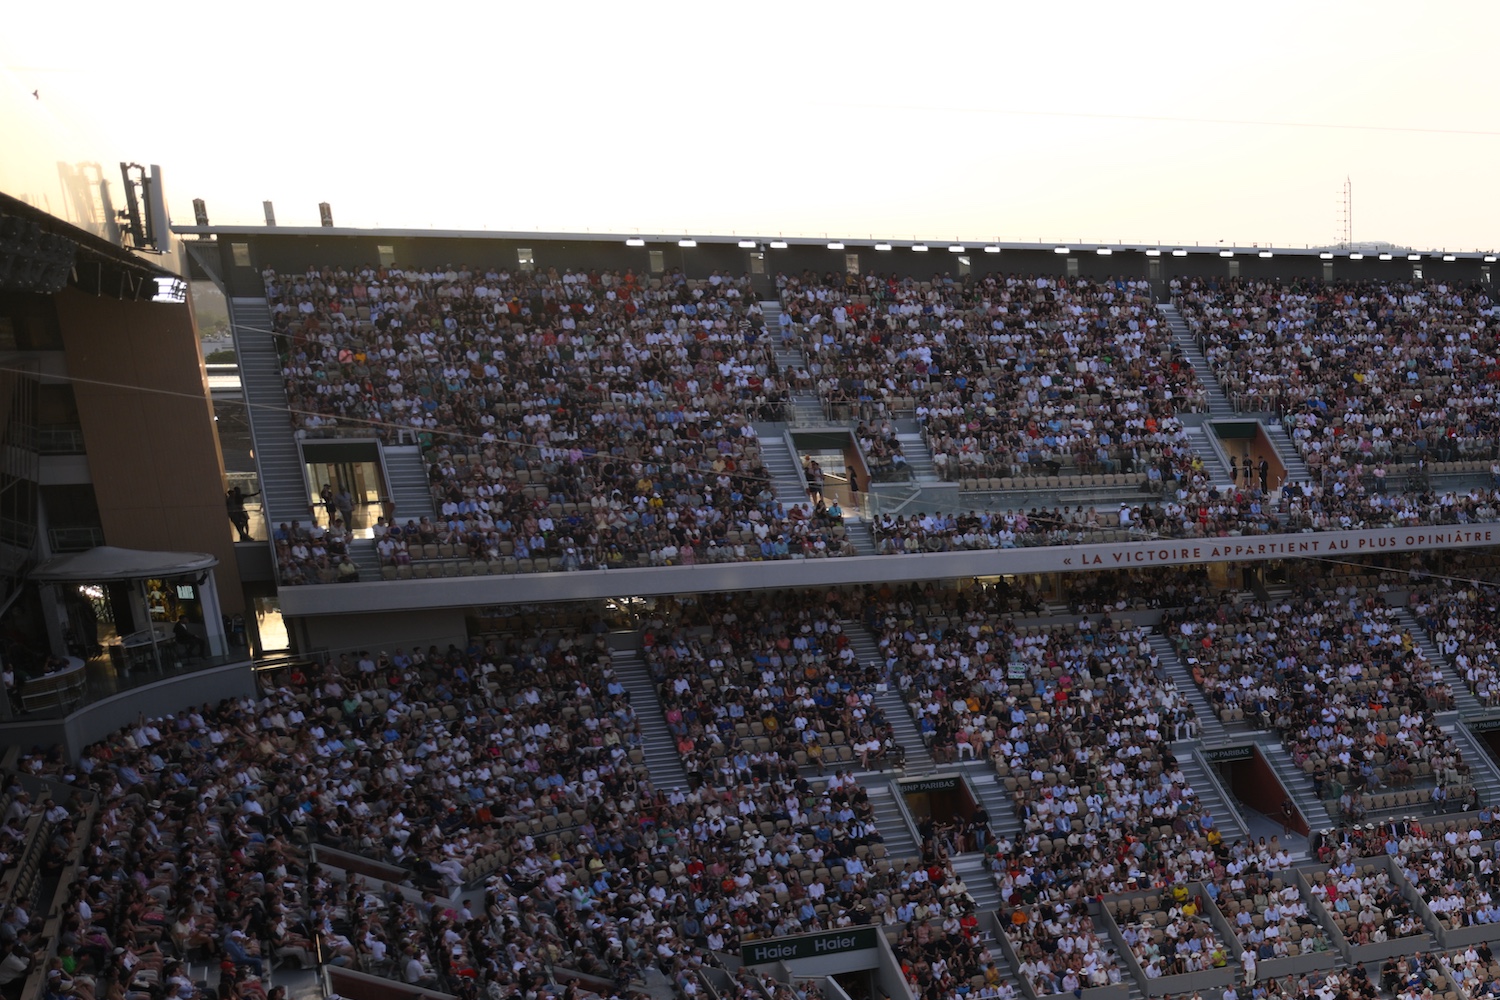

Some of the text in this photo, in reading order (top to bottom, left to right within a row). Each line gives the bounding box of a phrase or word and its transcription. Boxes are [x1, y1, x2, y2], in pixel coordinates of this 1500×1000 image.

[1082, 554, 1102, 565] LA
[1113, 548, 1201, 563] VICTOIRE
[1211, 541, 1320, 557] APPARTIENT
[1328, 540, 1349, 550] AU
[1359, 537, 1396, 548] PLUS
[1406, 530, 1492, 545] OPINIÂTRE
[1220, 748, 1250, 757] PARIBAS
[902, 780, 956, 792] BNP PARIBAS
[755, 944, 798, 960] Haier
[814, 936, 856, 952] Haier
